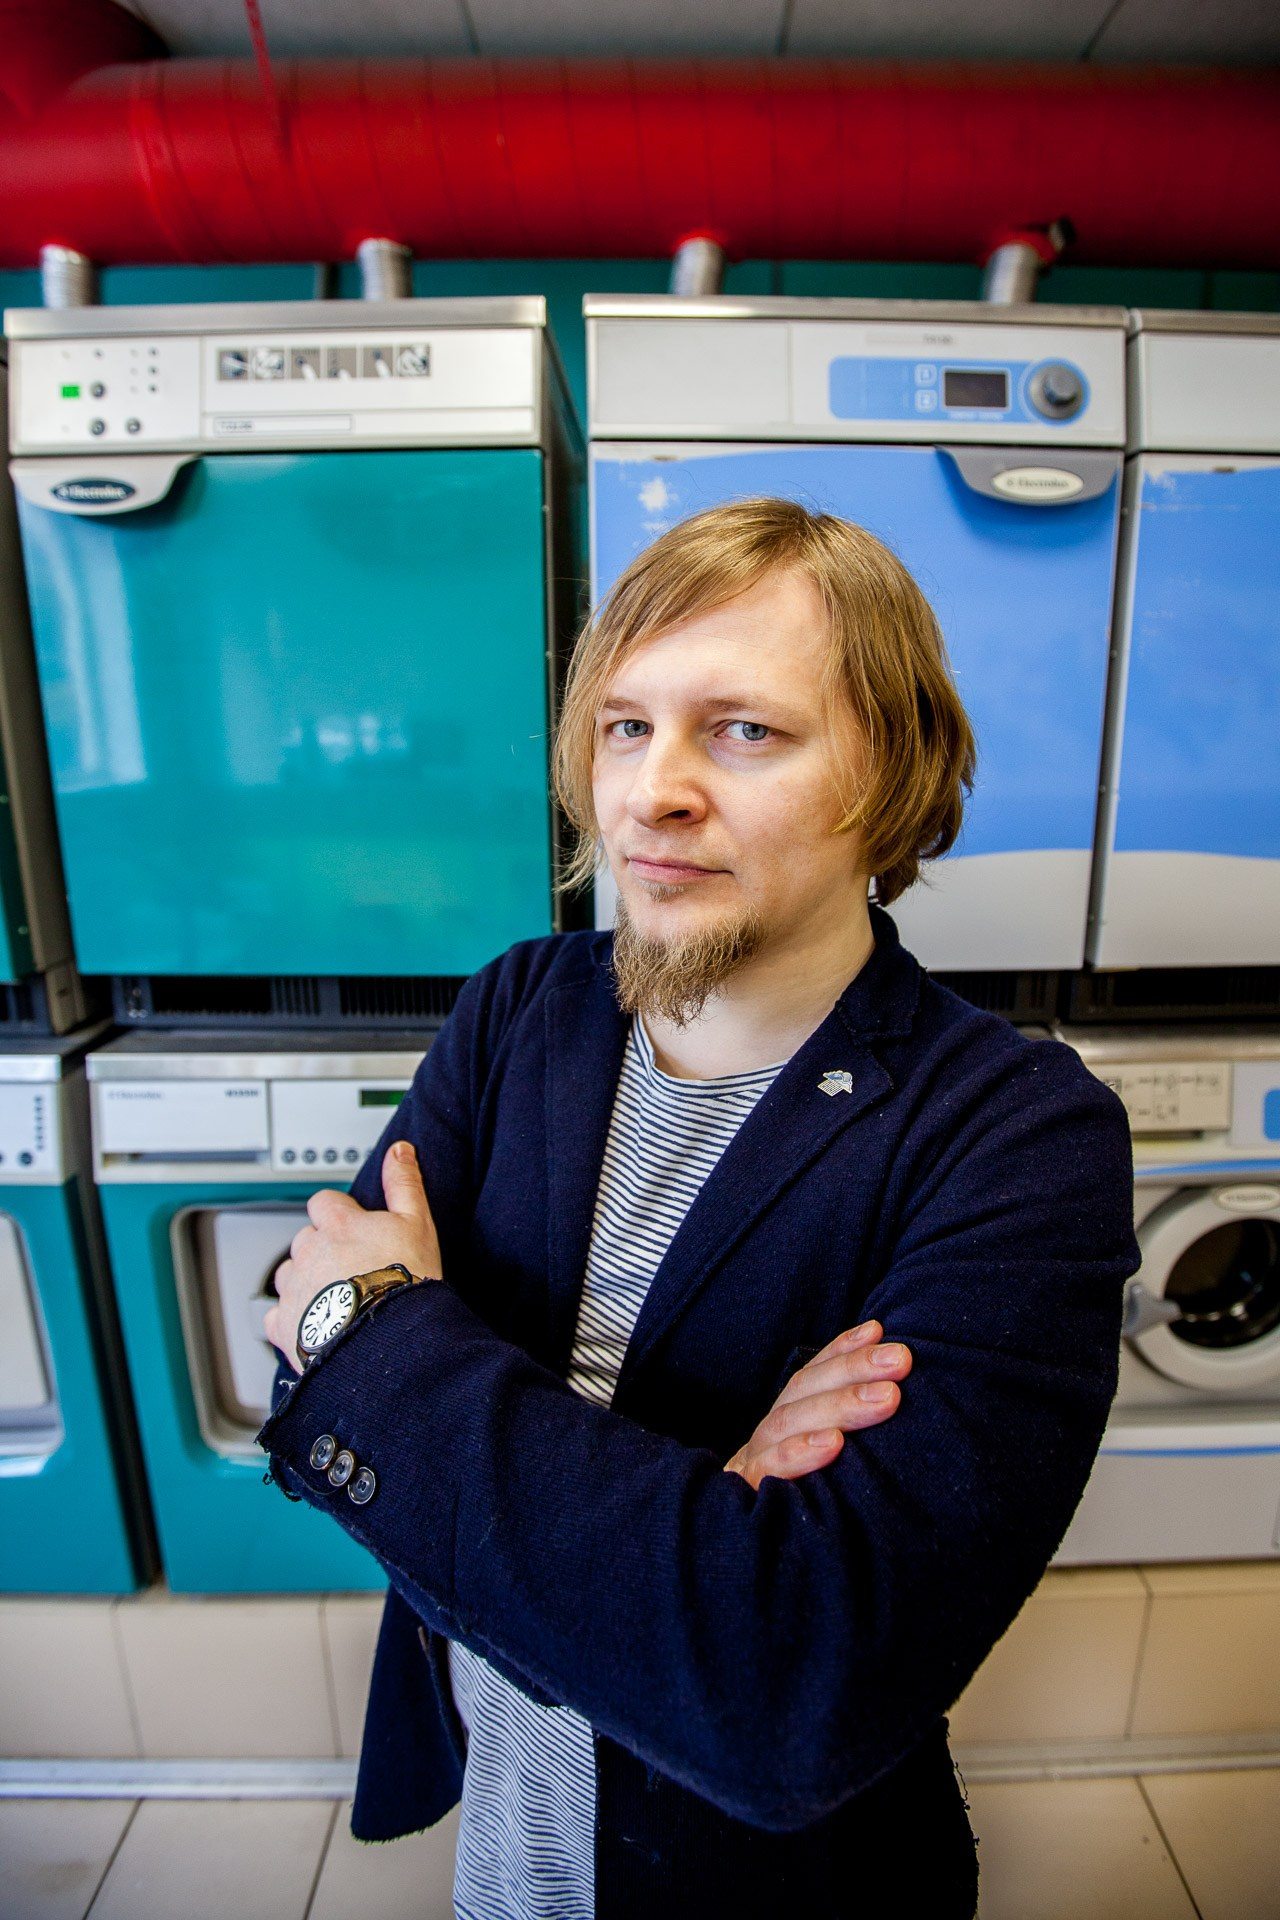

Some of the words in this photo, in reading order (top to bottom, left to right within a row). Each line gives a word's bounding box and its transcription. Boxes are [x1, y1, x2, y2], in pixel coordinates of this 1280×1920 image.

[68, 484, 126, 499] Electrolux
[316, 1296, 328, 1310] 3
[305, 1327, 317, 1341] 0
